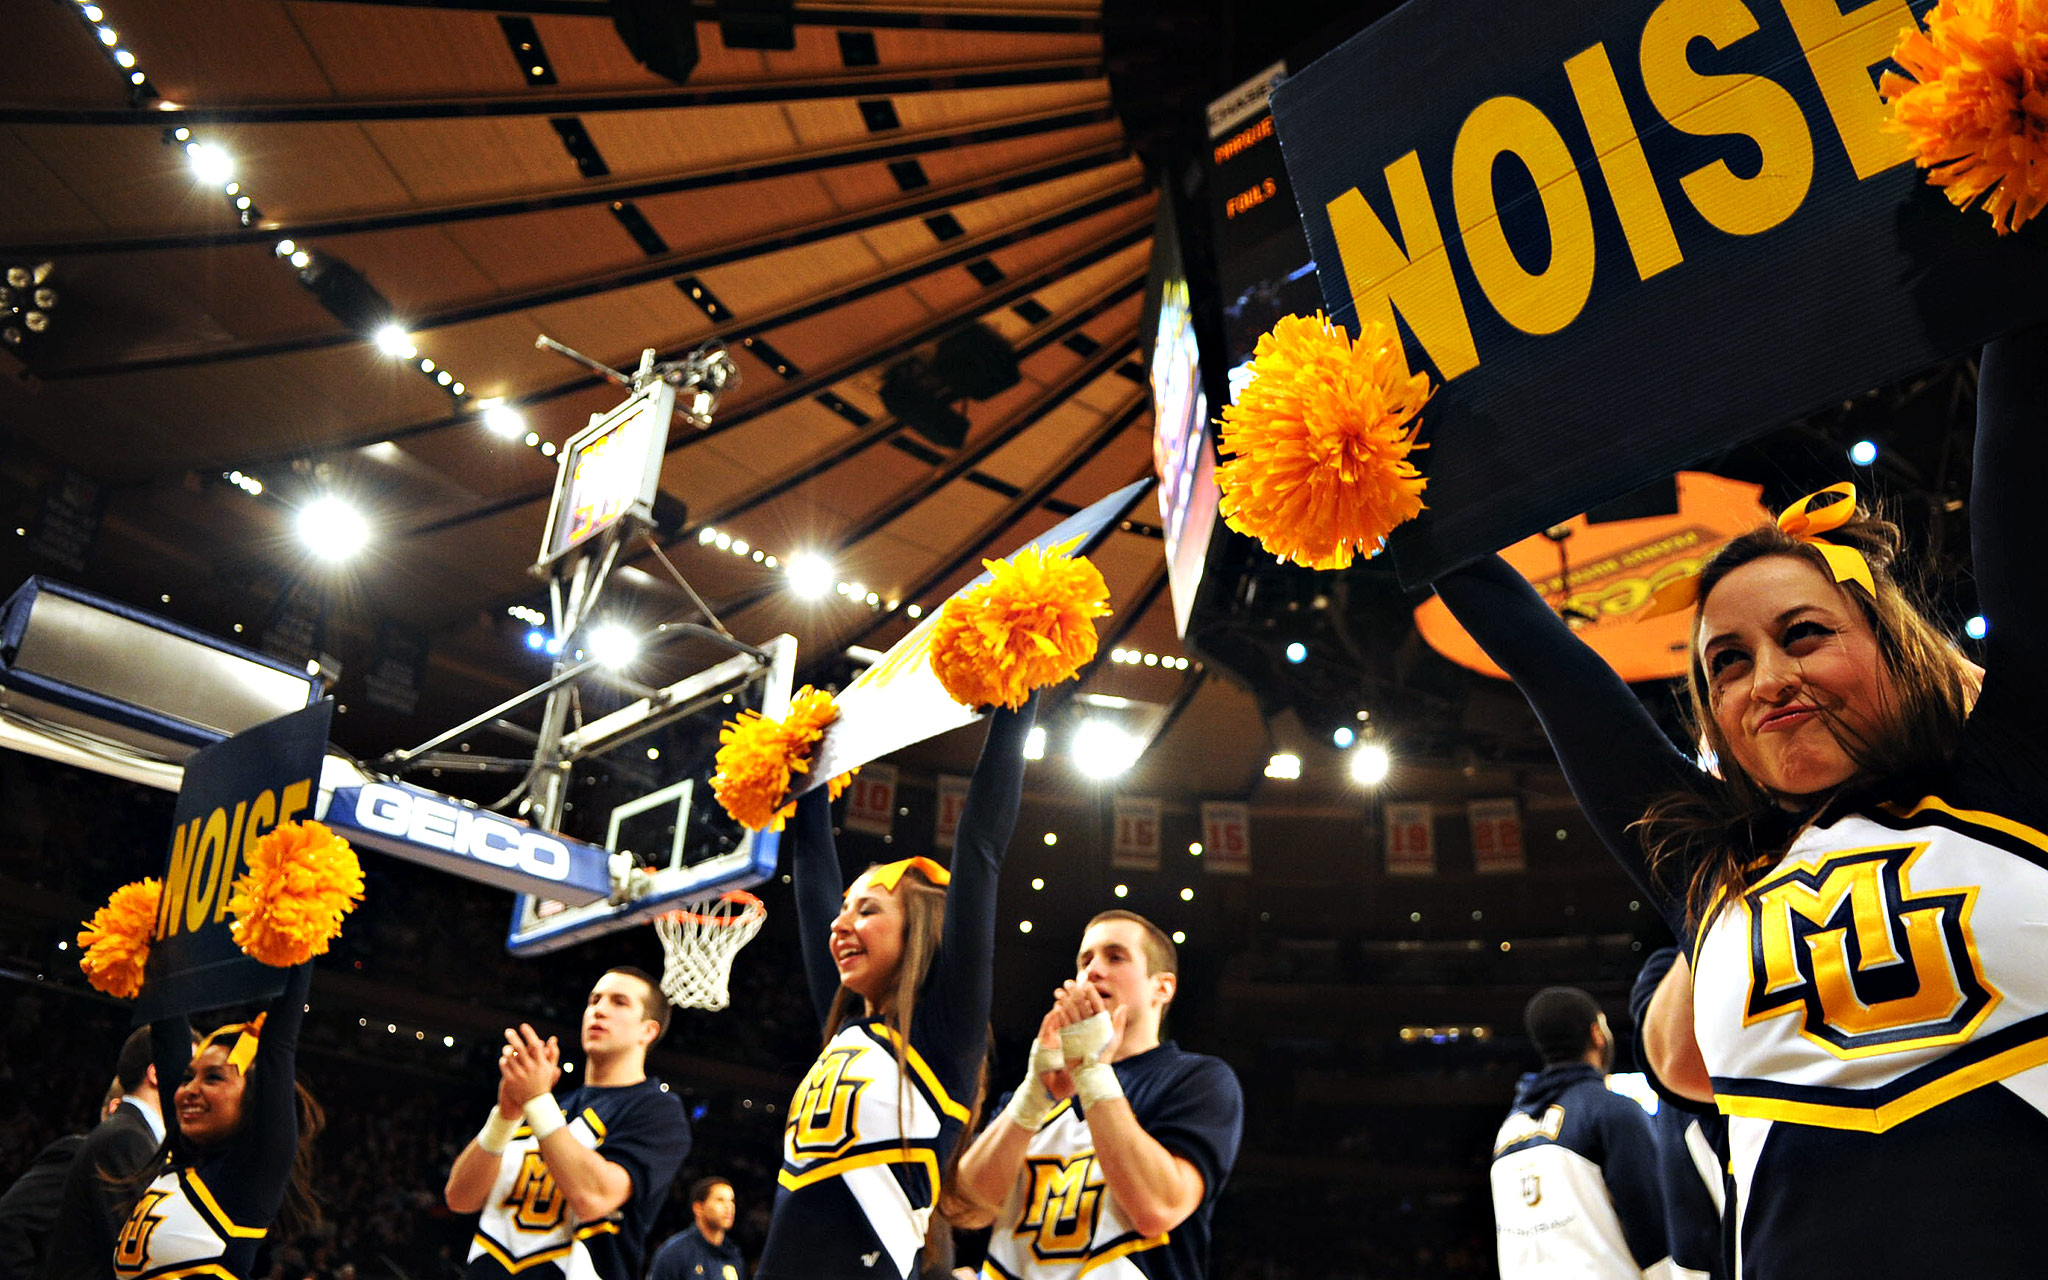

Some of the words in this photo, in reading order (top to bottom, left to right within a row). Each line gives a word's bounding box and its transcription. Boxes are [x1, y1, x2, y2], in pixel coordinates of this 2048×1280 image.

[1226, 177, 1277, 219] FOULS
[1326, 0, 1920, 382] NOISE
[355, 783, 570, 881] GEICO
[1744, 842, 2002, 1059] MU
[785, 1046, 874, 1160] MU
[1014, 1149, 1105, 1264] MU
